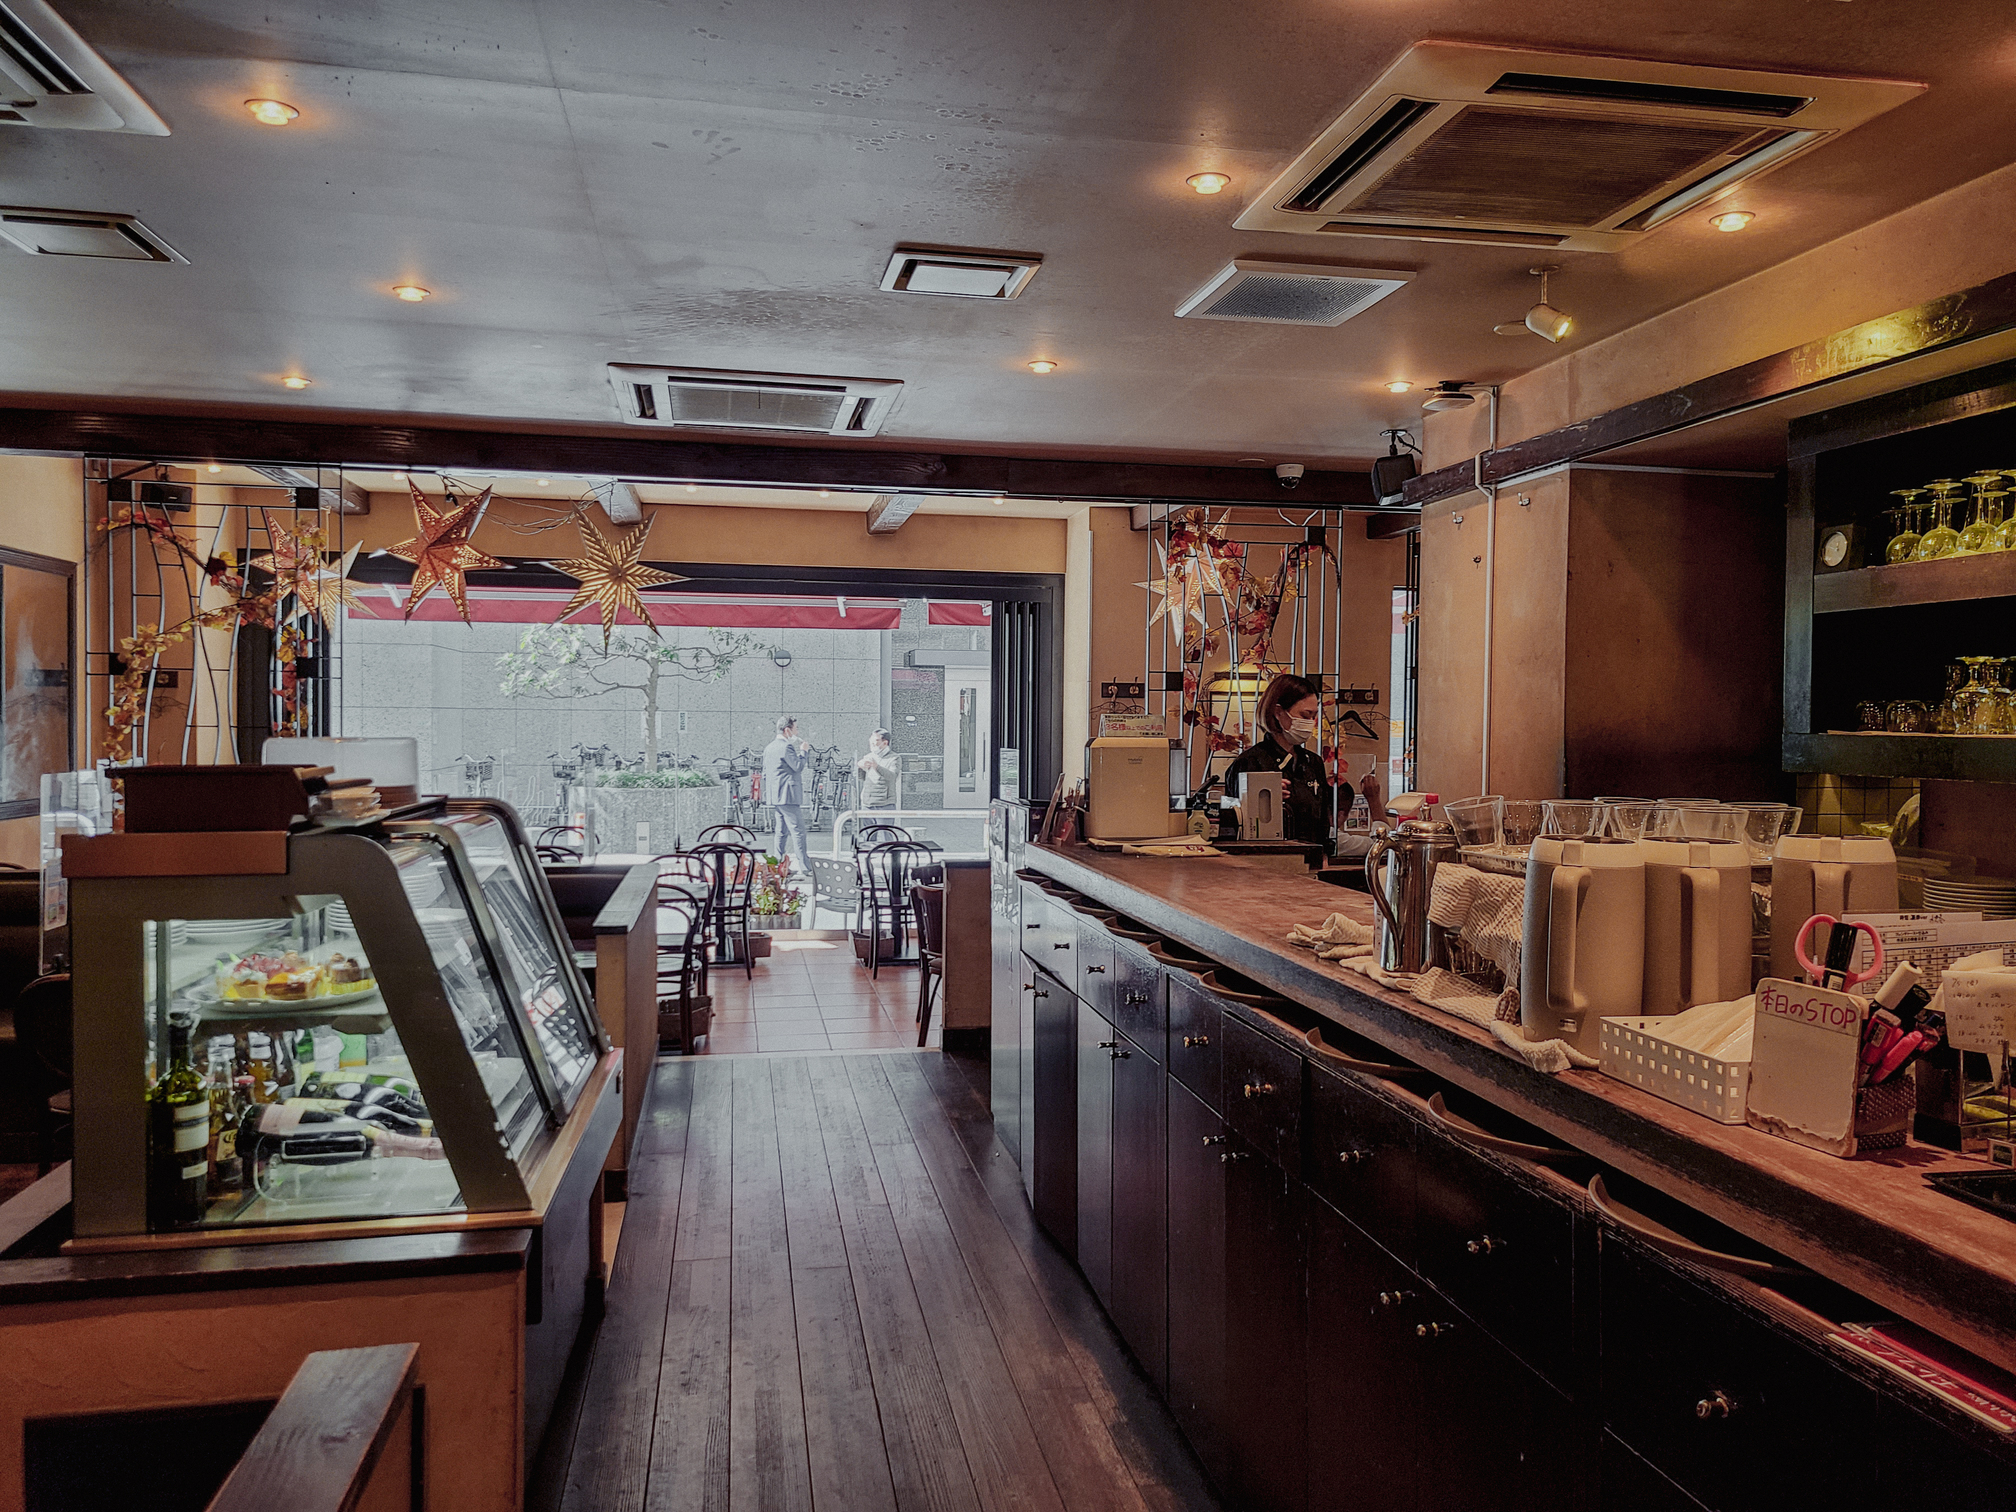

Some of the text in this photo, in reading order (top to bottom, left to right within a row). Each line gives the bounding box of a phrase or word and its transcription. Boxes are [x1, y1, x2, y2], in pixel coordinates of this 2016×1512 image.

[1105, 723, 1163, 731] 3名様以上でのご利用
[1761, 986, 1857, 1029] 本日のSTOP
